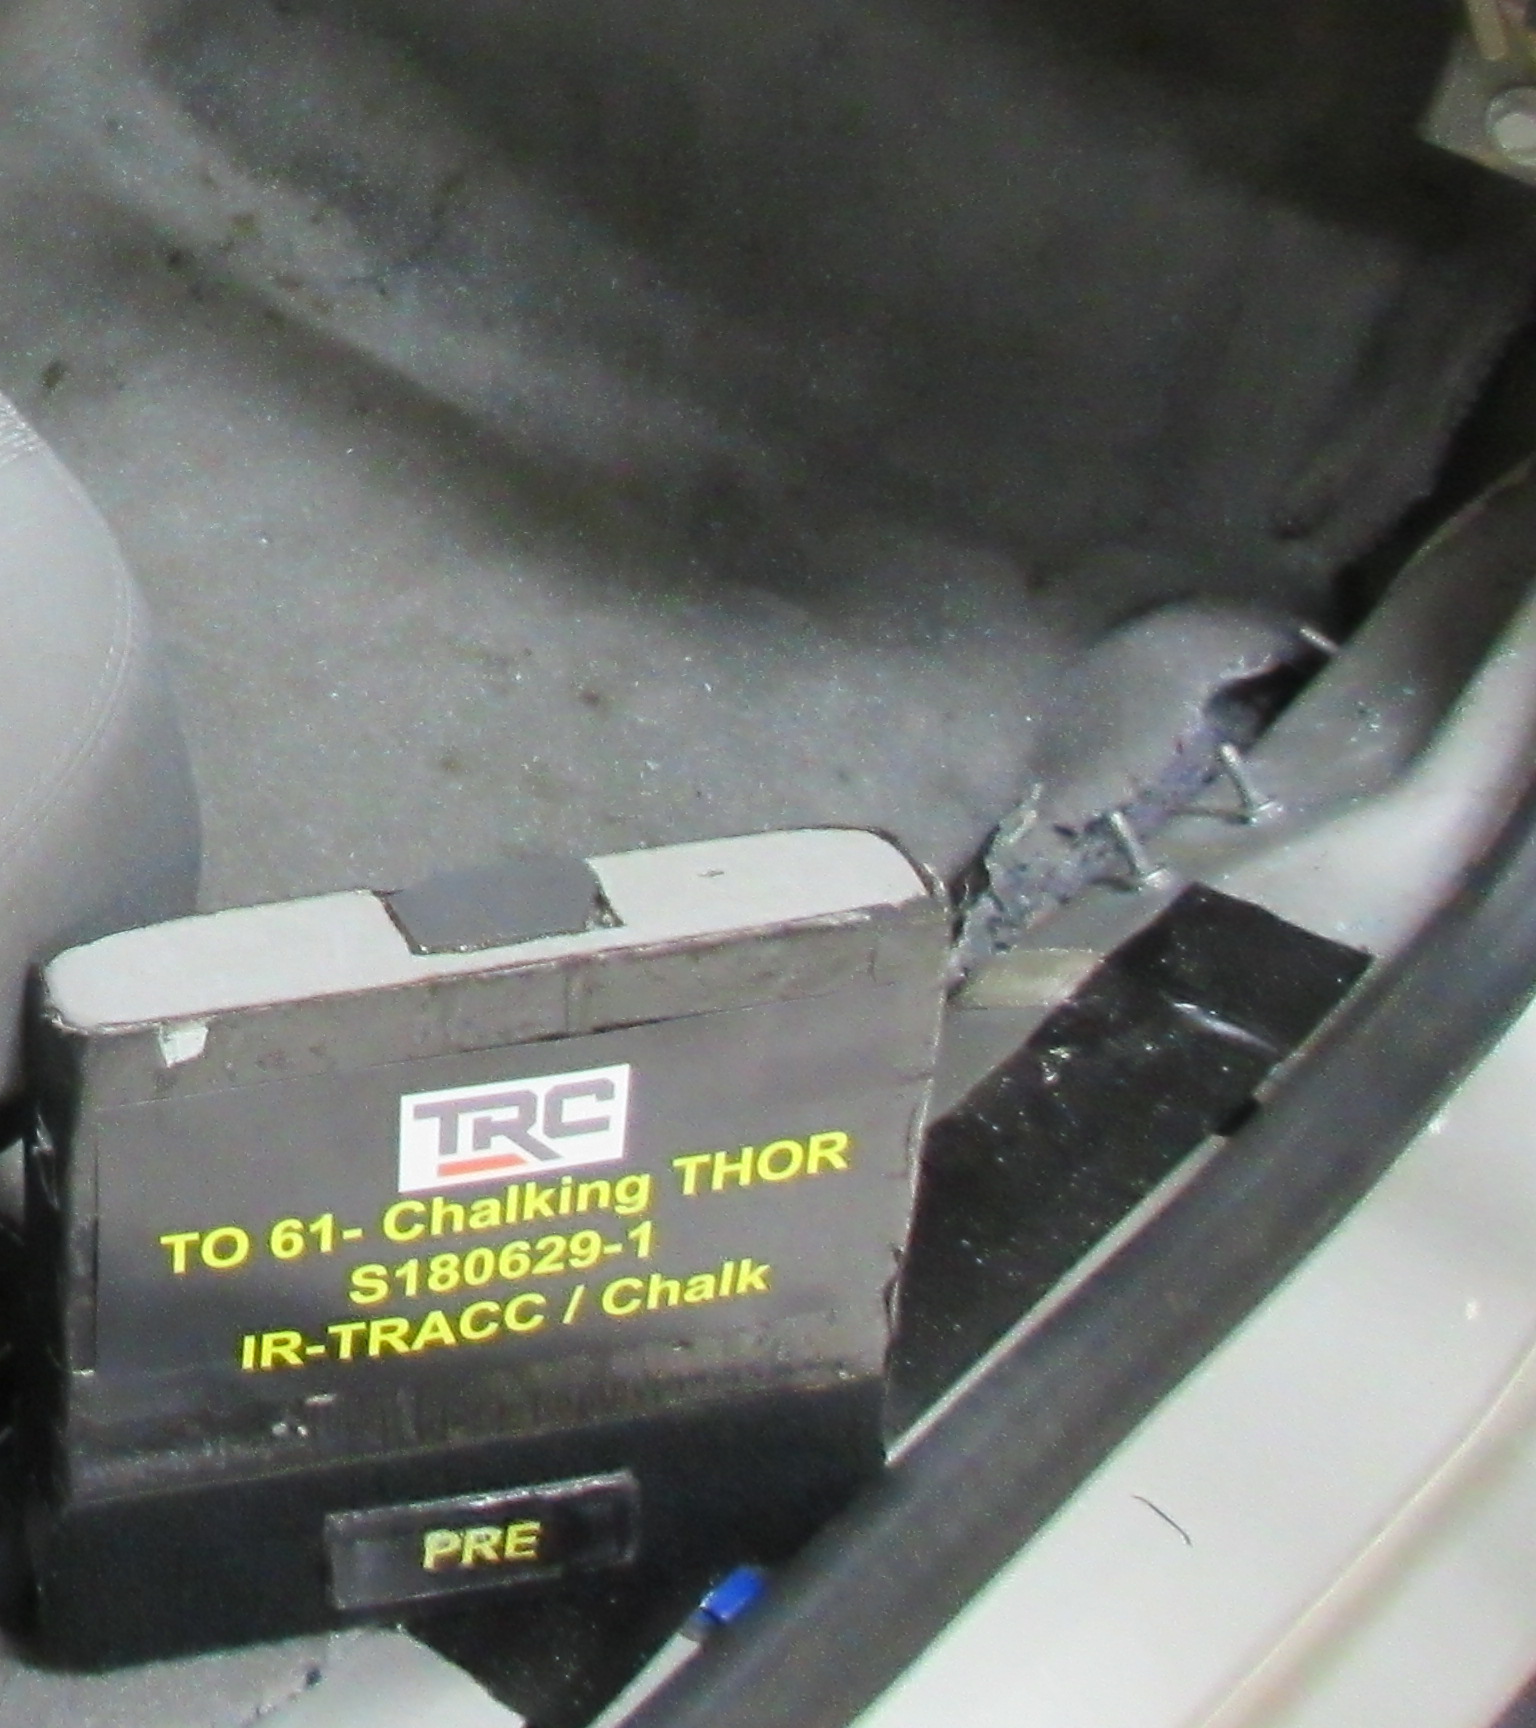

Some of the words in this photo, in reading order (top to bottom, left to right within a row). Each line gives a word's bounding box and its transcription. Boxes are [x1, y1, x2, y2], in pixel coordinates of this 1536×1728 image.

[414, 1078, 614, 1162] TRC
[159, 1225, 251, 1275] TO
[270, 1212, 364, 1261] 61-
[382, 1172, 652, 1243] Chalking
[672, 1130, 850, 1196] THOR
[348, 1220, 654, 1306] S180629-1
[240, 1292, 547, 1372] IR-TRACC
[561, 1284, 585, 1325] /
[601, 1257, 772, 1318] Chalk
[421, 1519, 543, 1570] PRE
